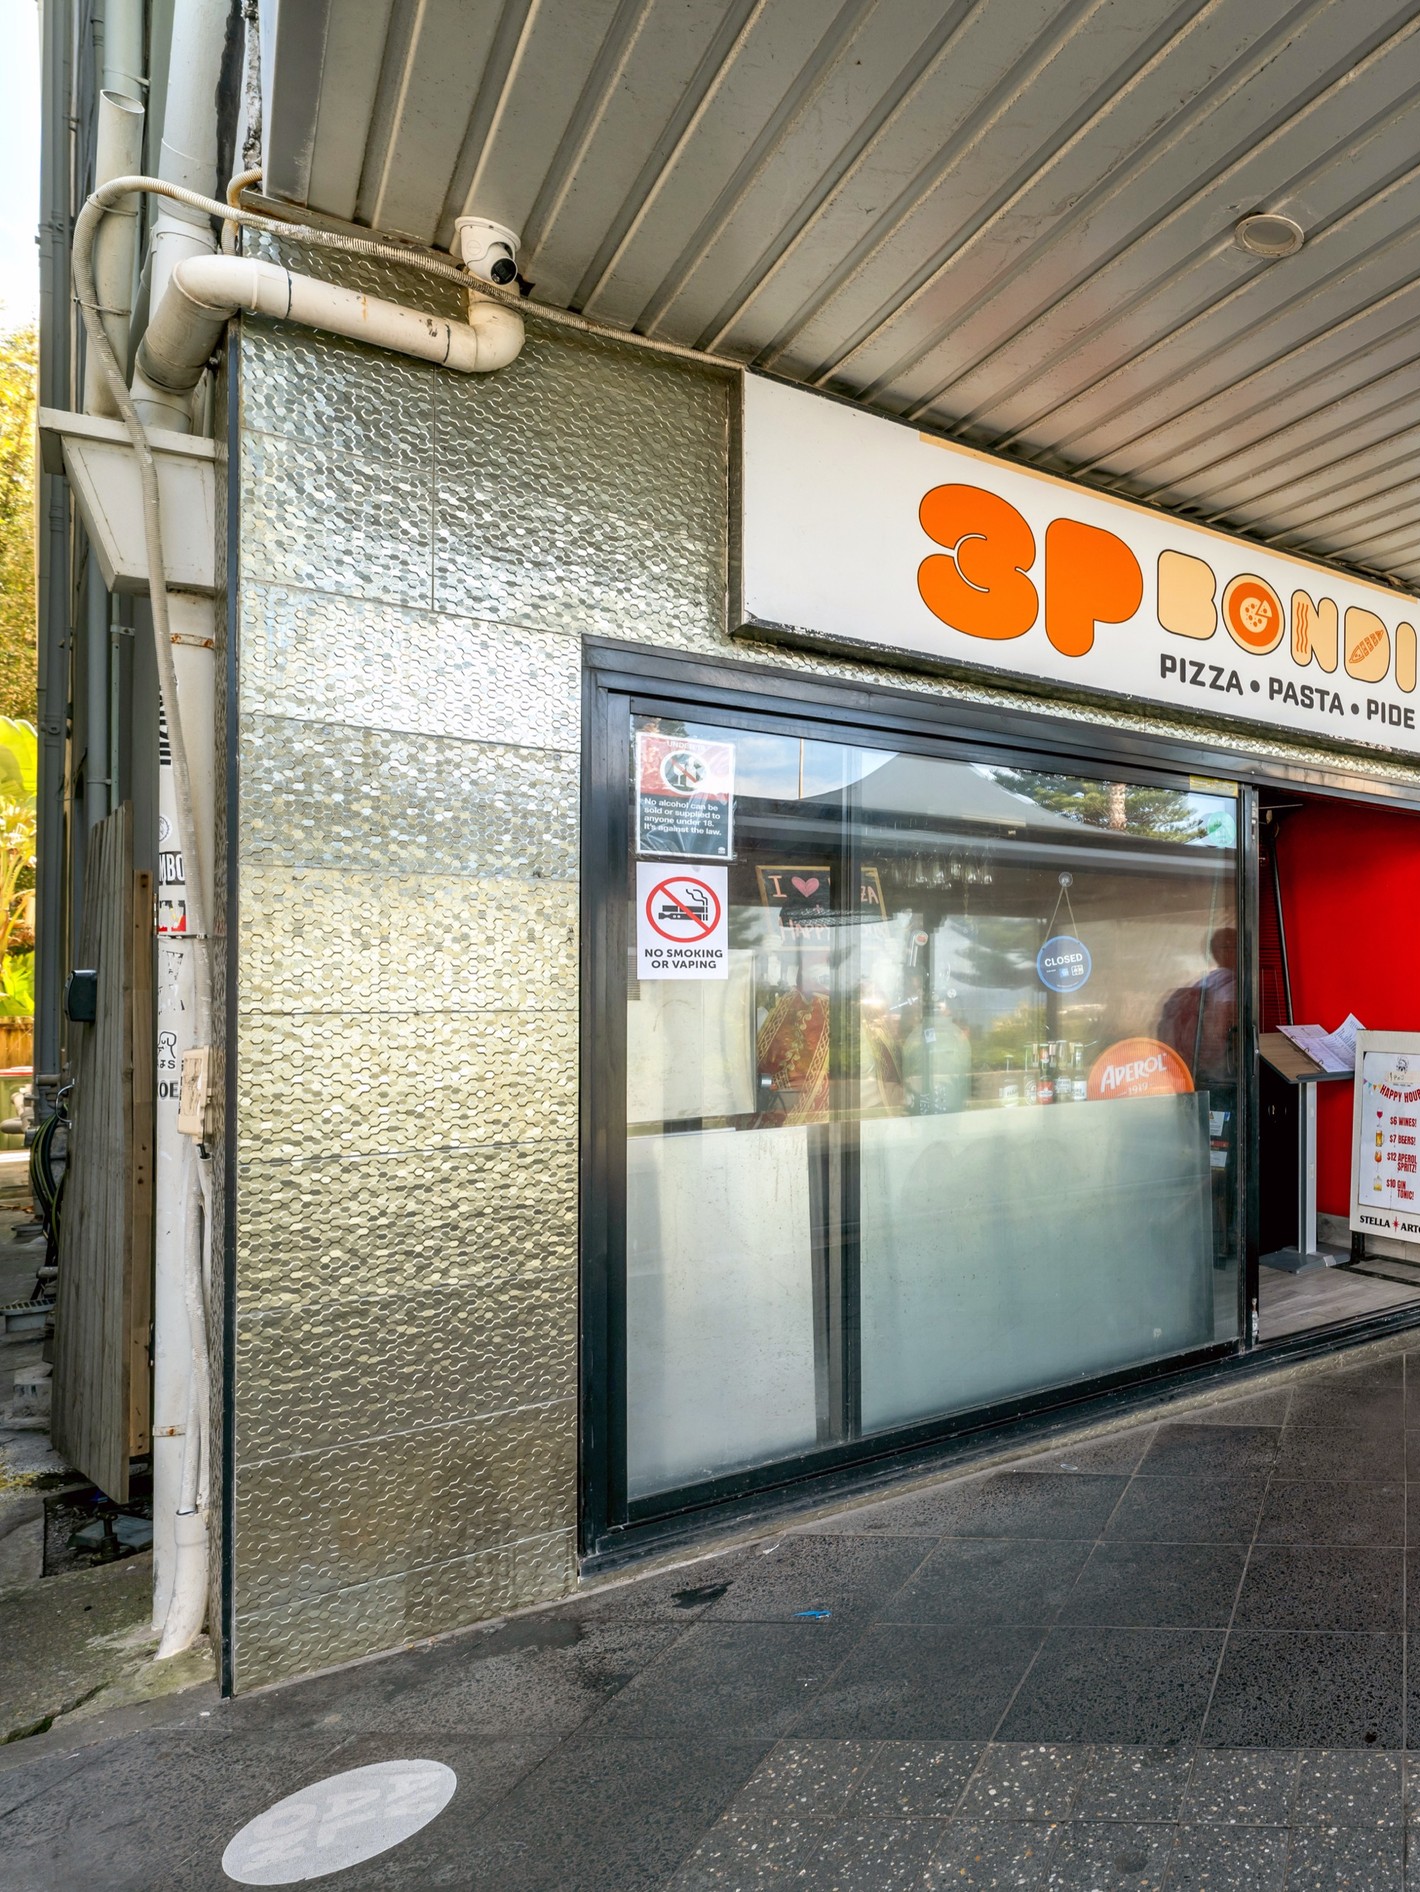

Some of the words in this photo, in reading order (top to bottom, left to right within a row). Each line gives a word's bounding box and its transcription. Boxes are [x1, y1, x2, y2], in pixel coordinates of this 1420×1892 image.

[917, 483, 1143, 657] 3P
[1156, 548, 1417, 693] BONDI
[1160, 653, 1243, 695] PIZZA
[1269, 677, 1344, 716] PASTA
[1367, 698, 1415, 729] PIDE
[659, 800, 689, 809] alcohol
[675, 809, 710, 819] supplied
[644, 816, 674, 824] anyone
[676, 817, 701, 826] under
[658, 824, 689, 833] against
[691, 826, 704, 834] the
[706, 828, 721, 836] law.
[645, 949, 663, 957] NO
[667, 949, 723, 958] SMOKING
[652, 960, 669, 969] OR
[672, 960, 716, 968] VAPING
[1044, 953, 1083, 967] CLOSED
[1100, 1054, 1167, 1093] APEROL
[1380, 1085, 1402, 1102] HAPPY
[1390, 1116, 1397, 1125] $6
[1399, 1117, 1416, 1127] WINES!
[1390, 1135, 1396, 1143] $7
[1398, 1135, 1416, 1146] BEERS!
[1387, 1152, 1396, 1160] $12
[1398, 1153, 1417, 1164] APEROL
[1398, 1162, 1416, 1173] SPRITZ!
[1386, 1179, 1396, 1188] $10
[1398, 1180, 1406, 1189] GIN
[1398, 1190, 1414, 1200] TONIC!
[1360, 1215, 1390, 1228] STELLA
